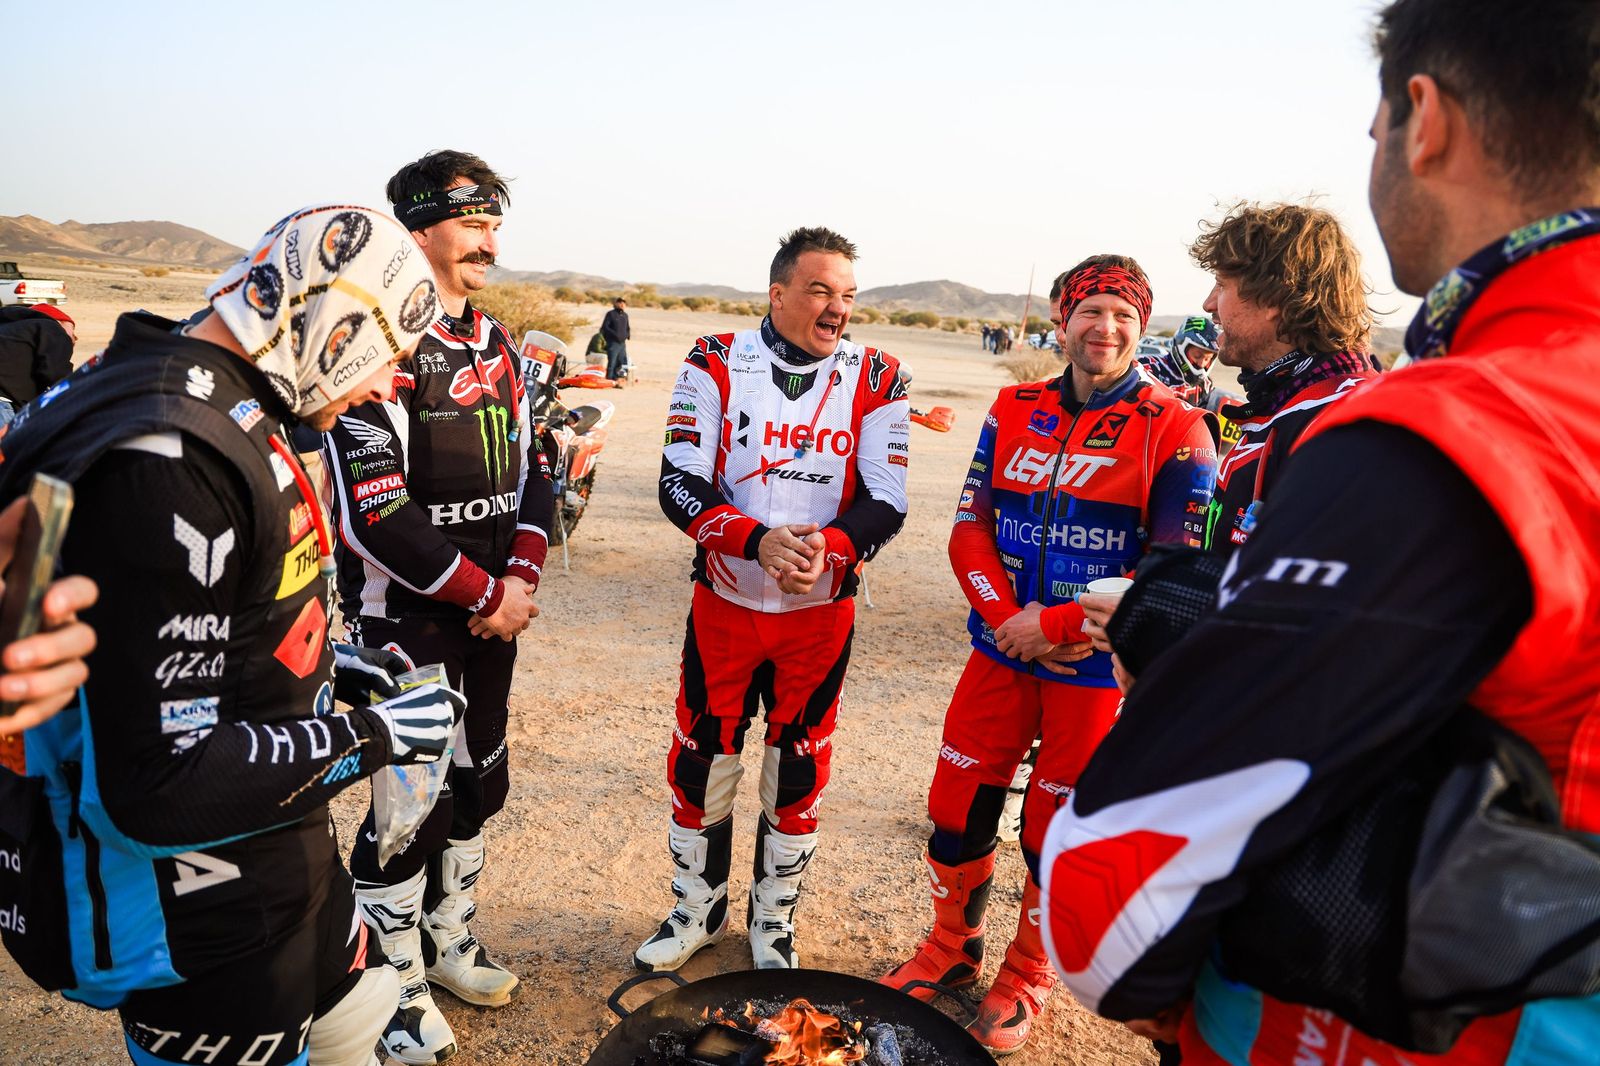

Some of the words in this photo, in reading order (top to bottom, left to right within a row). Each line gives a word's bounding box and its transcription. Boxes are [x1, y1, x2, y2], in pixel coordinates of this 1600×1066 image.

[448, 196, 484, 204] HONDA
[285, 229, 302, 280] MIRA
[383, 240, 412, 288] MIRA
[333, 346, 379, 387] MIRA
[523, 359, 543, 379] 16
[346, 446, 395, 460] HONDA
[762, 419, 855, 458] Hero
[1004, 446, 1117, 488] LEATT
[357, 476, 405, 498] MOTUL
[359, 488, 408, 512] SHOWA
[669, 481, 702, 517] Hero
[1086, 564, 1109, 576] BIT
[158, 613, 231, 642] MIRA
